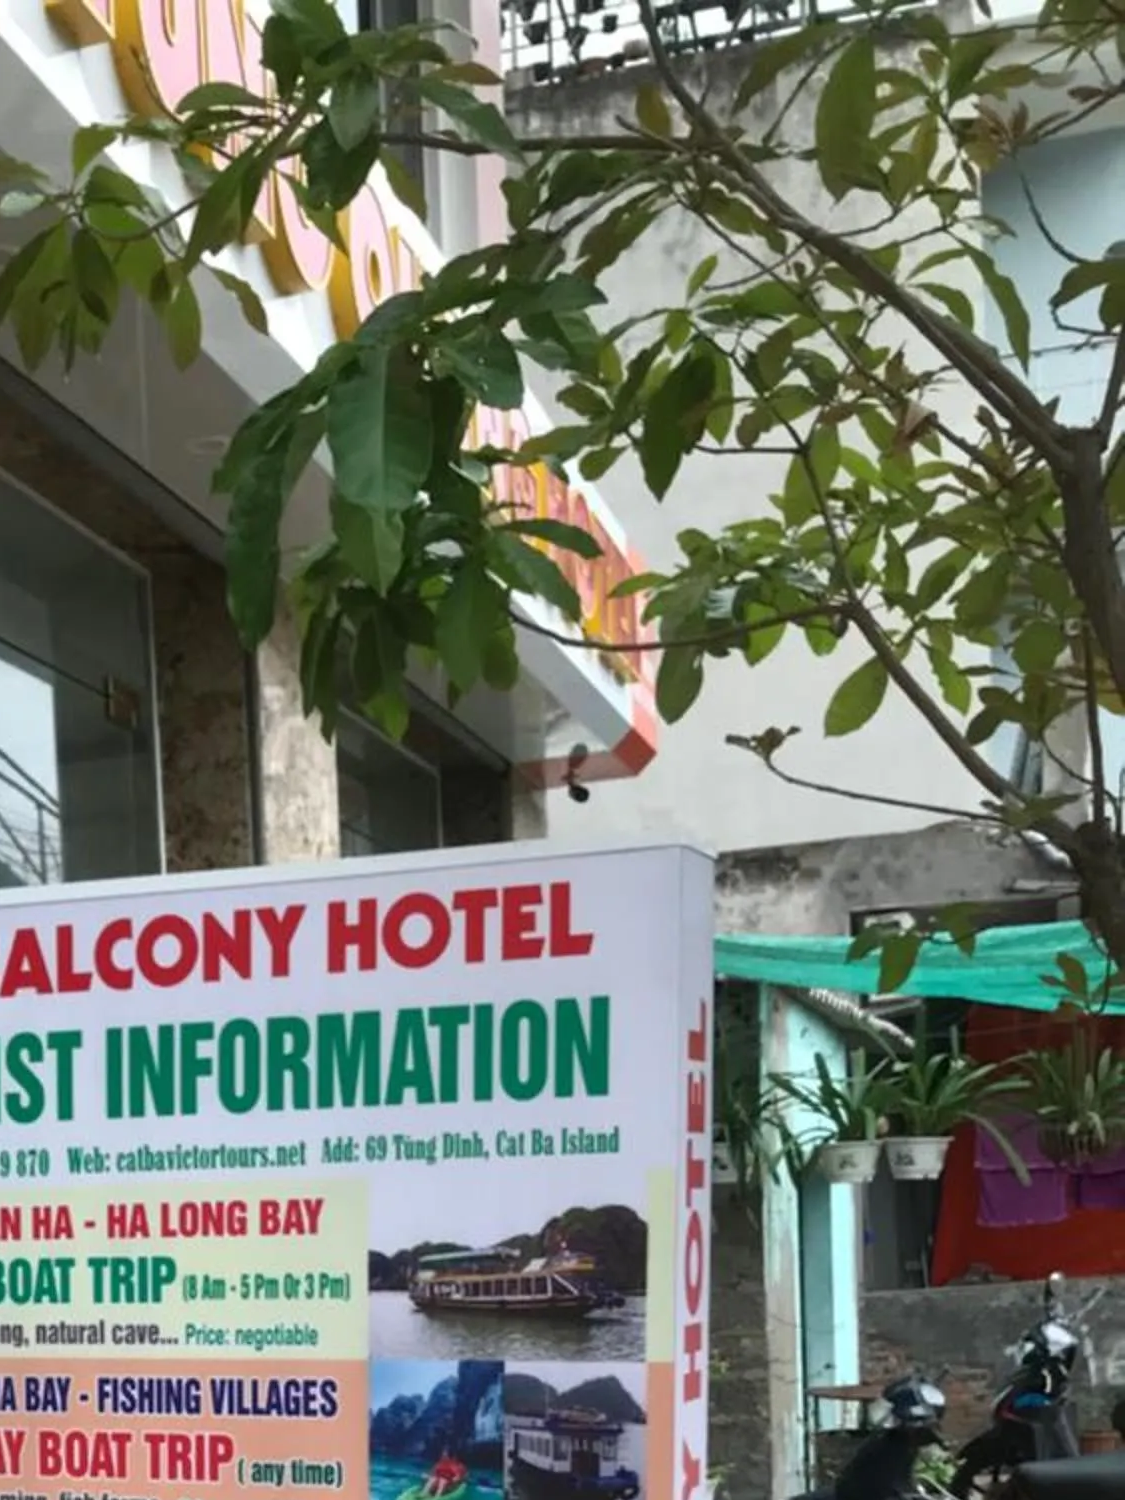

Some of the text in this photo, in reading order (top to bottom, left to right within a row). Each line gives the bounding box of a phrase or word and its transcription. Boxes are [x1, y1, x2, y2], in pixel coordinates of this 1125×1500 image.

[328, 881, 594, 973] HOTEL
[106, 996, 610, 1119] INFORMATION
[17, 1149, 50, 1177] 870
[67, 1147, 110, 1174] Web:
[116, 1142, 306, 1172] catbavictortours.net
[322, 1136, 360, 1164] Add:
[365, 1135, 387, 1162] 69
[496, 1130, 525, 1157] Cat
[531, 1129, 554, 1155] Ba
[561, 1126, 620, 1154] Island
[32, 1205, 74, 1240] HA
[107, 1203, 150, 1239] HA
[160, 1200, 248, 1238] LONG
[259, 1198, 324, 1236] BAY
[683, 997, 707, 1403] HOTEL
[88, 1256, 177, 1304] TRIP
[36, 1322, 105, 1345] natural
[185, 1323, 230, 1345] Price:
[235, 1323, 319, 1351] negotiable
[26, 1377, 71, 1412] BAY
[97, 1377, 202, 1415] FISHING
[210, 1378, 338, 1417] VILLAGES
[39, 1431, 135, 1479] BOAT
[144, 1433, 234, 1482] TRIP
[291, 1458, 342, 1488] time)
